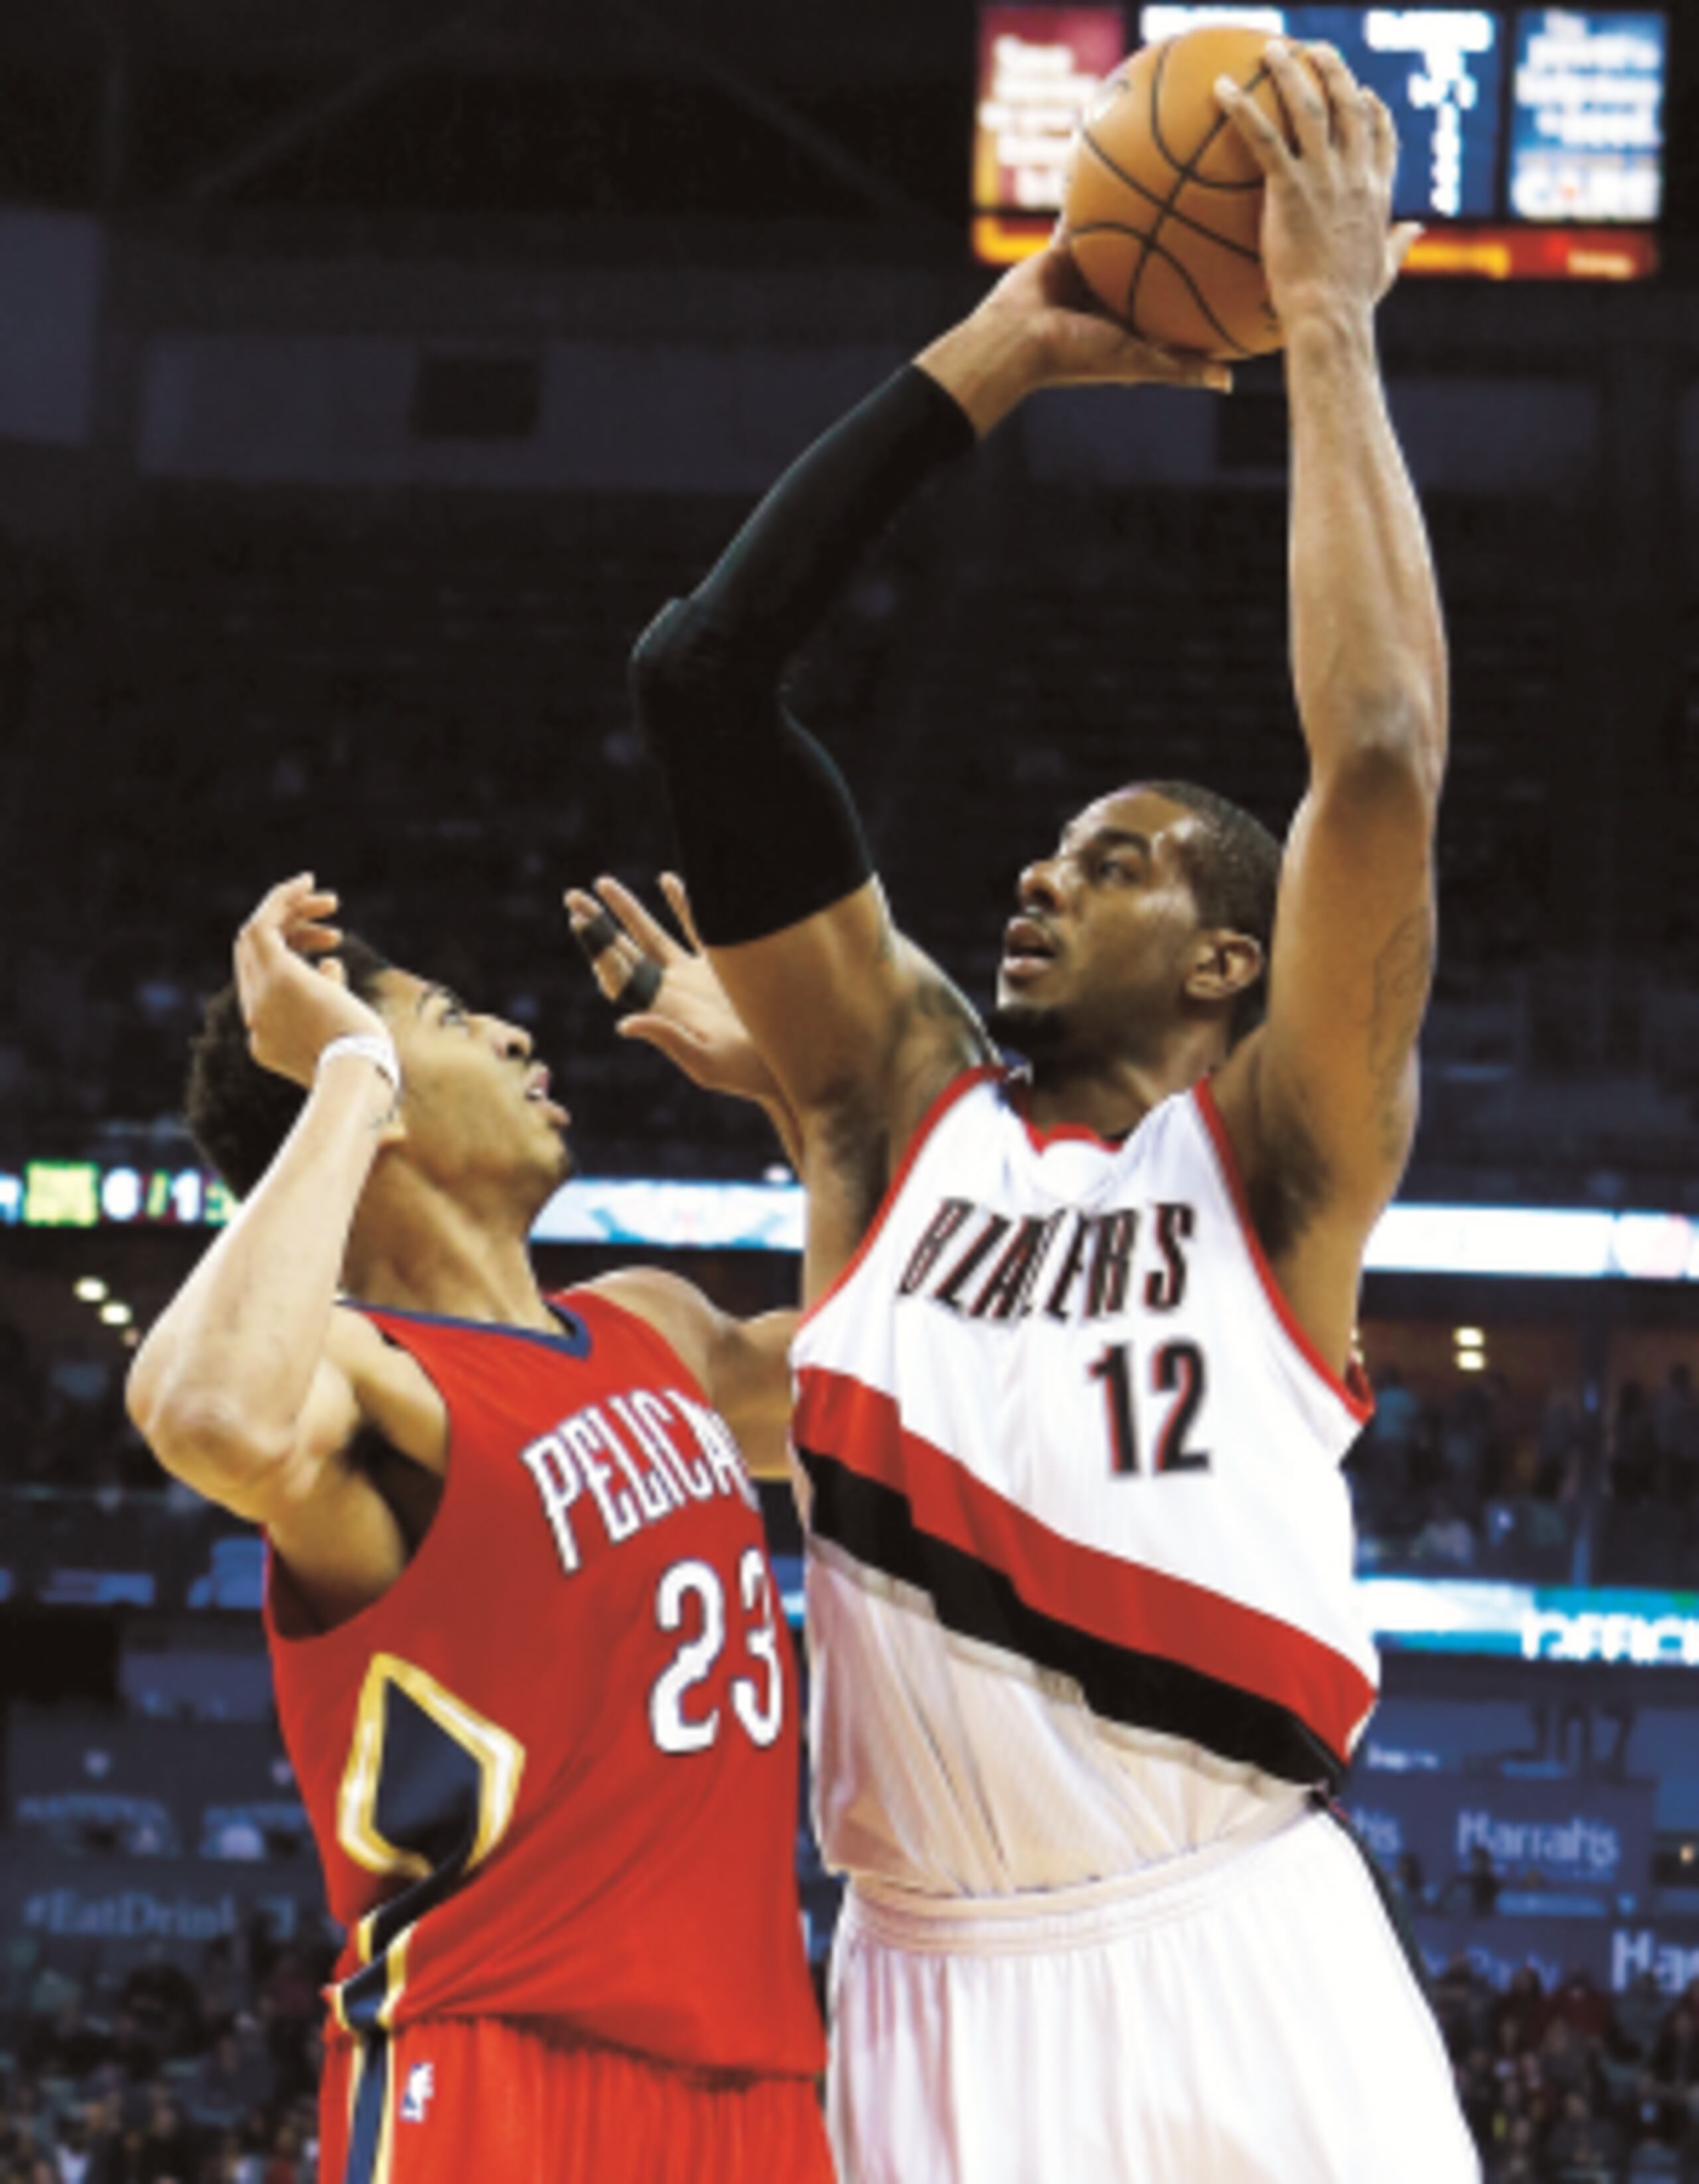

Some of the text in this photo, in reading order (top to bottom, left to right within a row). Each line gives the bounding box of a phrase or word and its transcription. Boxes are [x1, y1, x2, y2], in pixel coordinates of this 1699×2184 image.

[895, 1196, 1197, 1321] BLAERS
[520, 1387, 761, 1575] PELICA
[1086, 1336, 1214, 1479] 12
[648, 1543, 785, 1755] 23
